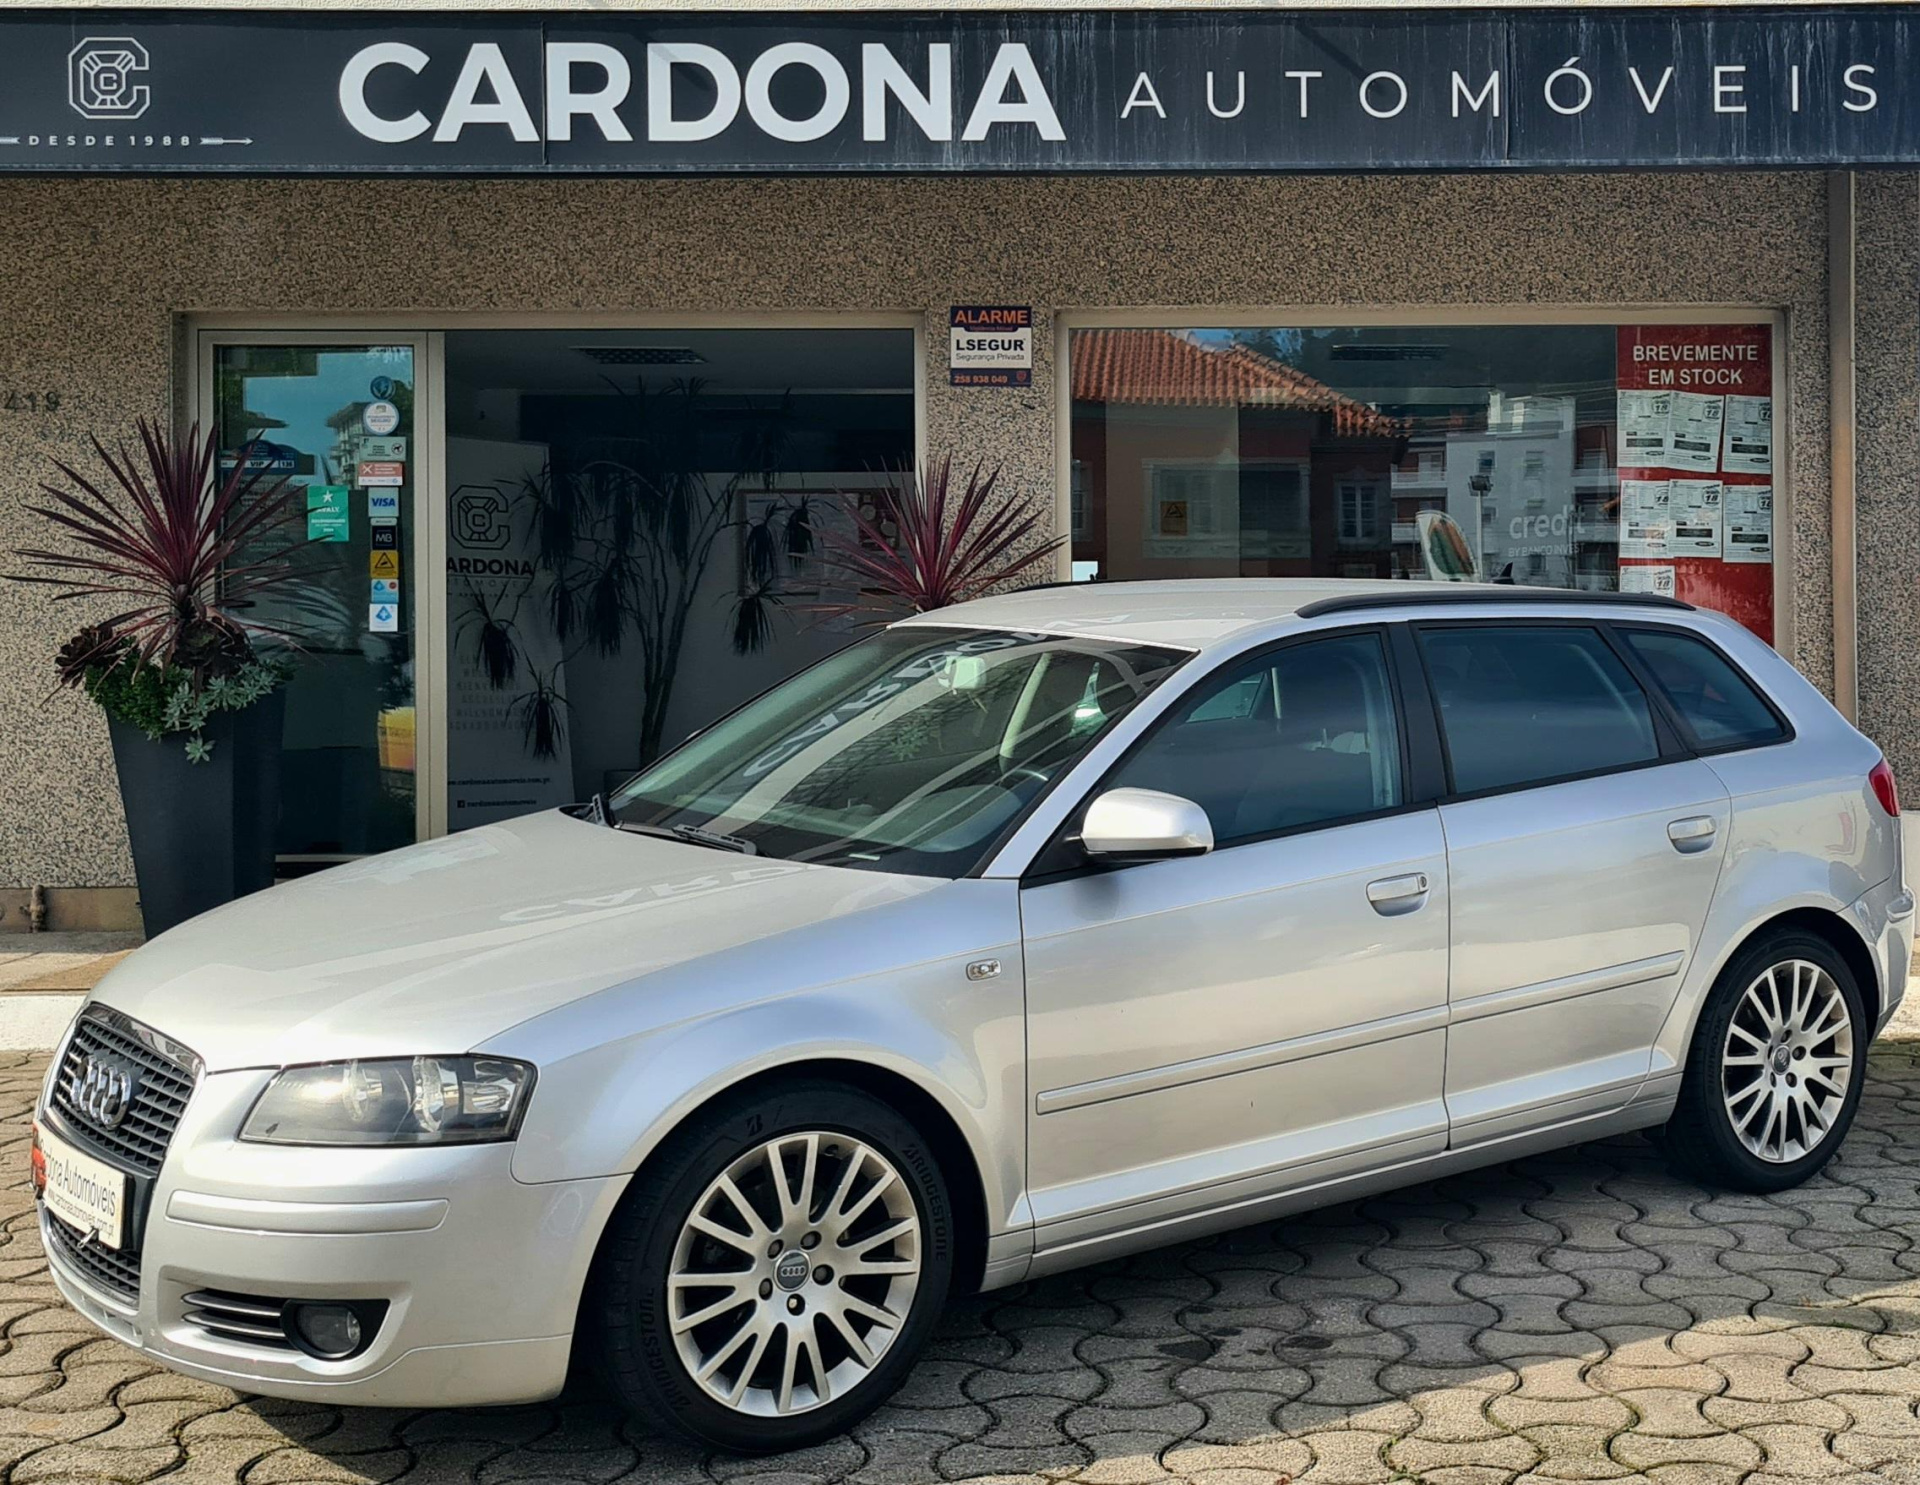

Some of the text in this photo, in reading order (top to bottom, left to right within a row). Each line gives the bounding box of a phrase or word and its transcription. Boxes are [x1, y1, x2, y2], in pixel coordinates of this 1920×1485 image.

[339, 42, 1878, 143] CARDONA AUTOMÓVEIS
[28, 136, 191, 146] DESDE 1988
[954, 309, 1028, 324] ALARME
[956, 339, 1024, 351] LSEGUR
[956, 353, 1025, 362] Segurança Privada
[1632, 345, 1758, 362] BREVEMENTE
[1648, 368, 1743, 386] EM STOCK
[371, 498, 396, 507] VISA
[1509, 504, 1586, 540] credit
[375, 534, 392, 543] MB
[1508, 543, 1586, 557] BY BANCO INVEST
[446, 557, 534, 576] ARDONA
[62, 1157, 116, 1217] Automóveis
[902, 1143, 947, 1262] BRIDGESTONE
